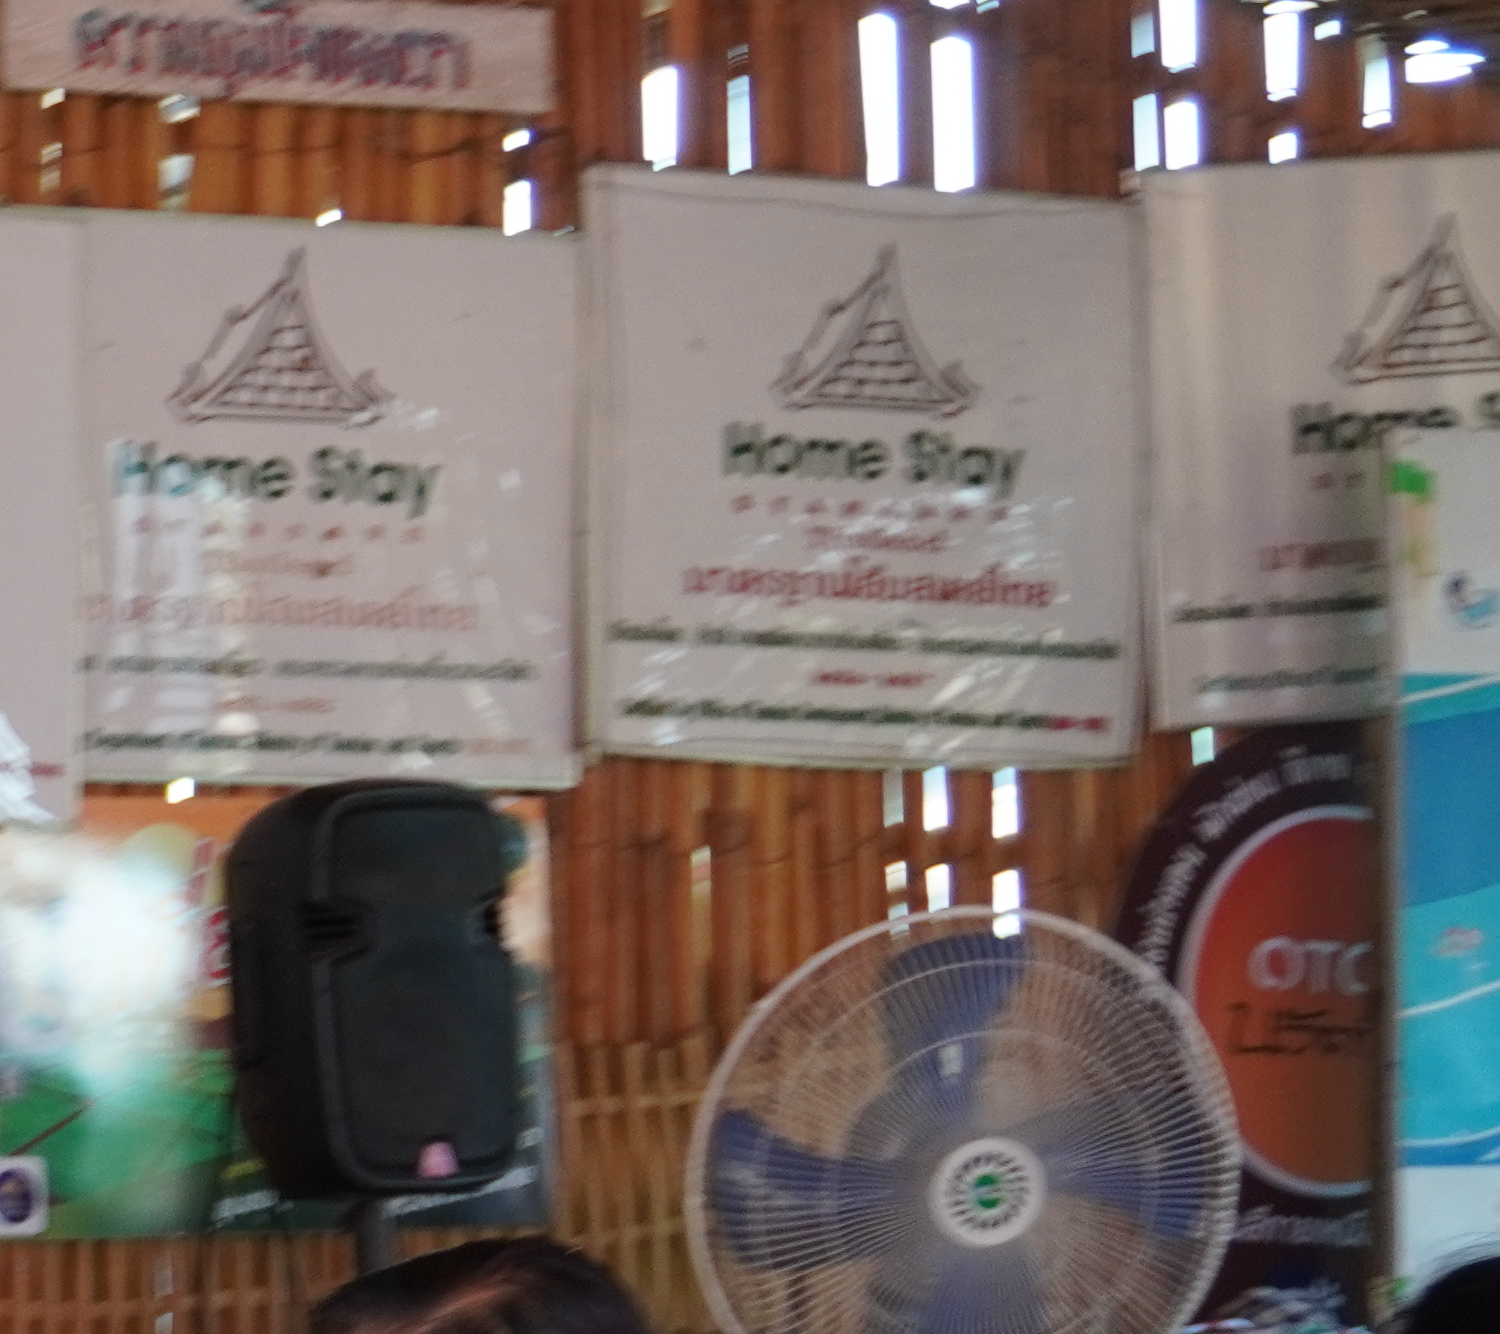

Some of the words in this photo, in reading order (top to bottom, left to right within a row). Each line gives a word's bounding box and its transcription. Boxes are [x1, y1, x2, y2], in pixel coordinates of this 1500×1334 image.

[110, 441, 293, 503] Home
[307, 446, 441, 519] Stay
[723, 421, 888, 482] Home
[905, 428, 1027, 500] Stay
